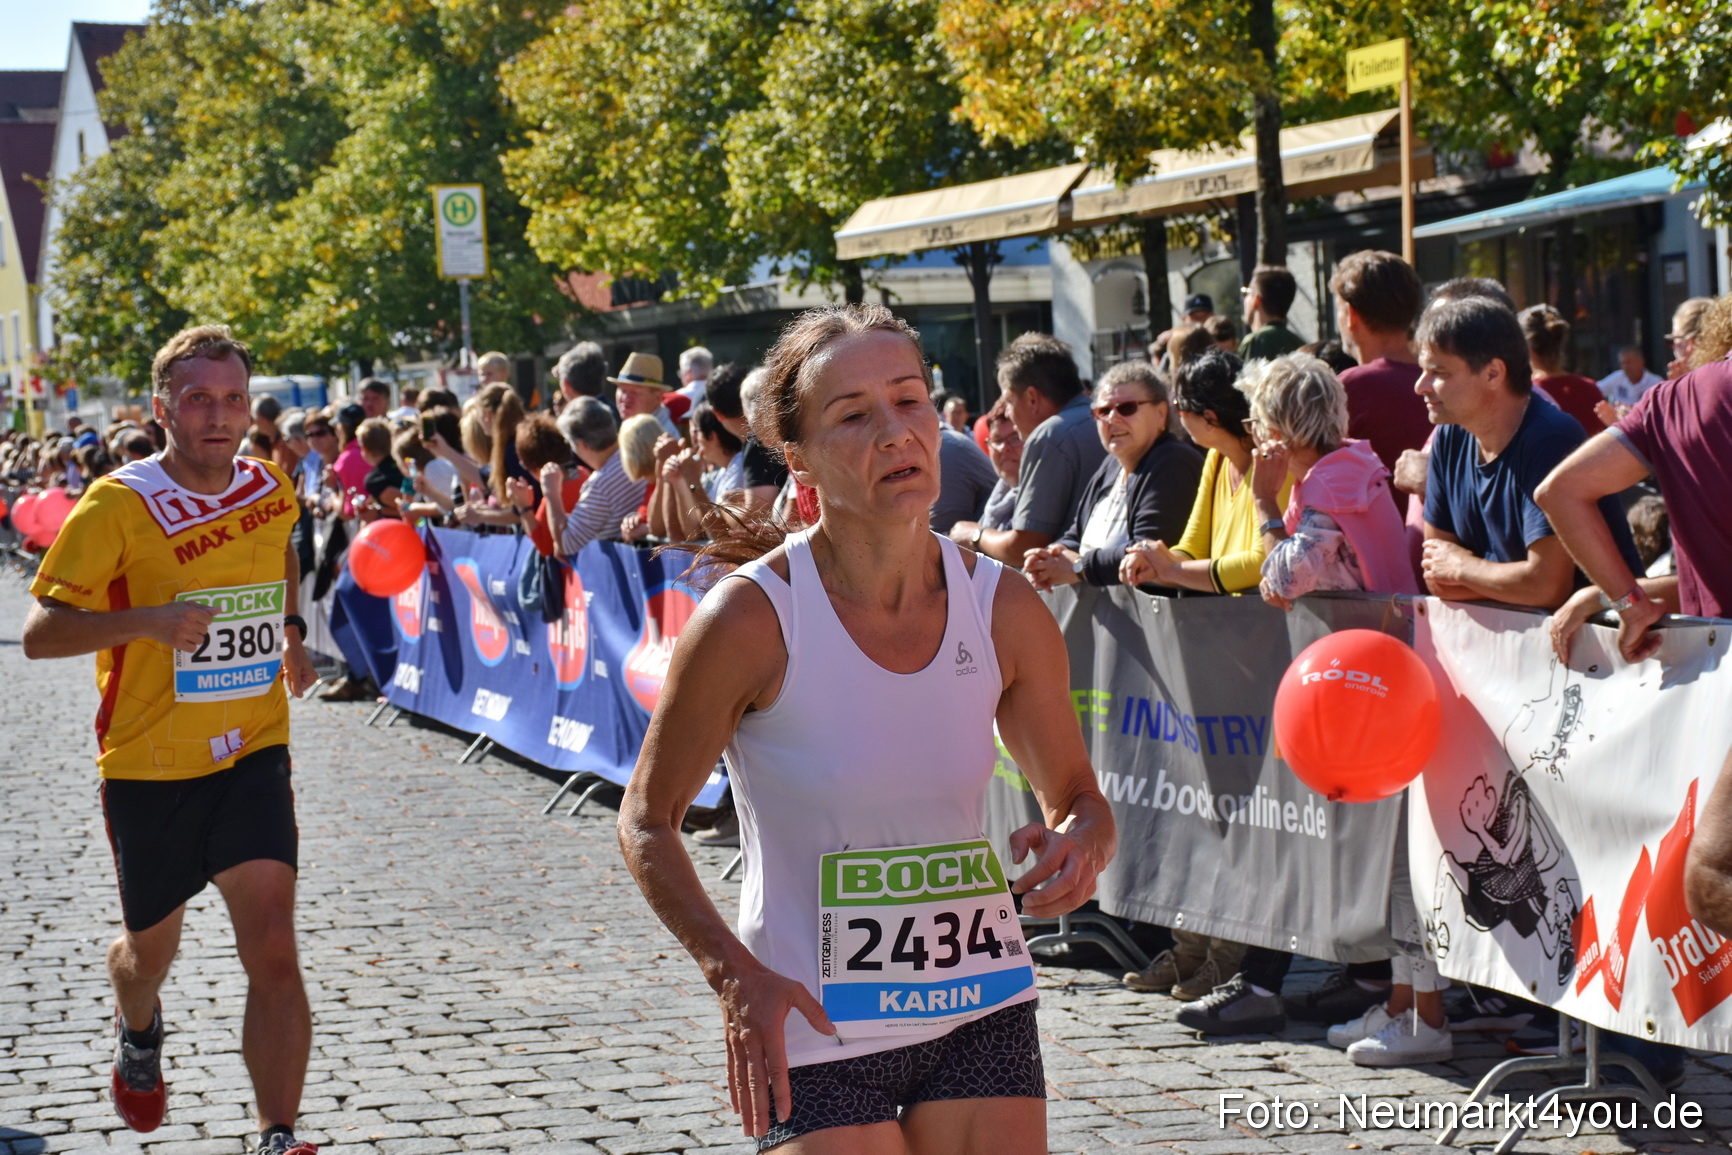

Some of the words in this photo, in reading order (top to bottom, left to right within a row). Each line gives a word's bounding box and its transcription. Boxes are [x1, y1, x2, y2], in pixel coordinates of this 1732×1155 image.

[1359, 57, 1400, 77] Toiletten
[173, 525, 236, 565] MAX
[190, 622, 274, 663] 2380
[197, 667, 271, 689] MICHAEL
[955, 665, 978, 677] odlo
[1344, 682, 1387, 698] energie
[1121, 696, 1267, 756] INDUSTRY
[840, 850, 993, 896] BOCK
[999, 909, 1008, 920] D
[847, 908, 1004, 971] 2434
[1651, 918, 1727, 990] Brau
[1698, 964, 1723, 985] Sicher
[879, 983, 981, 1013] KARIN
